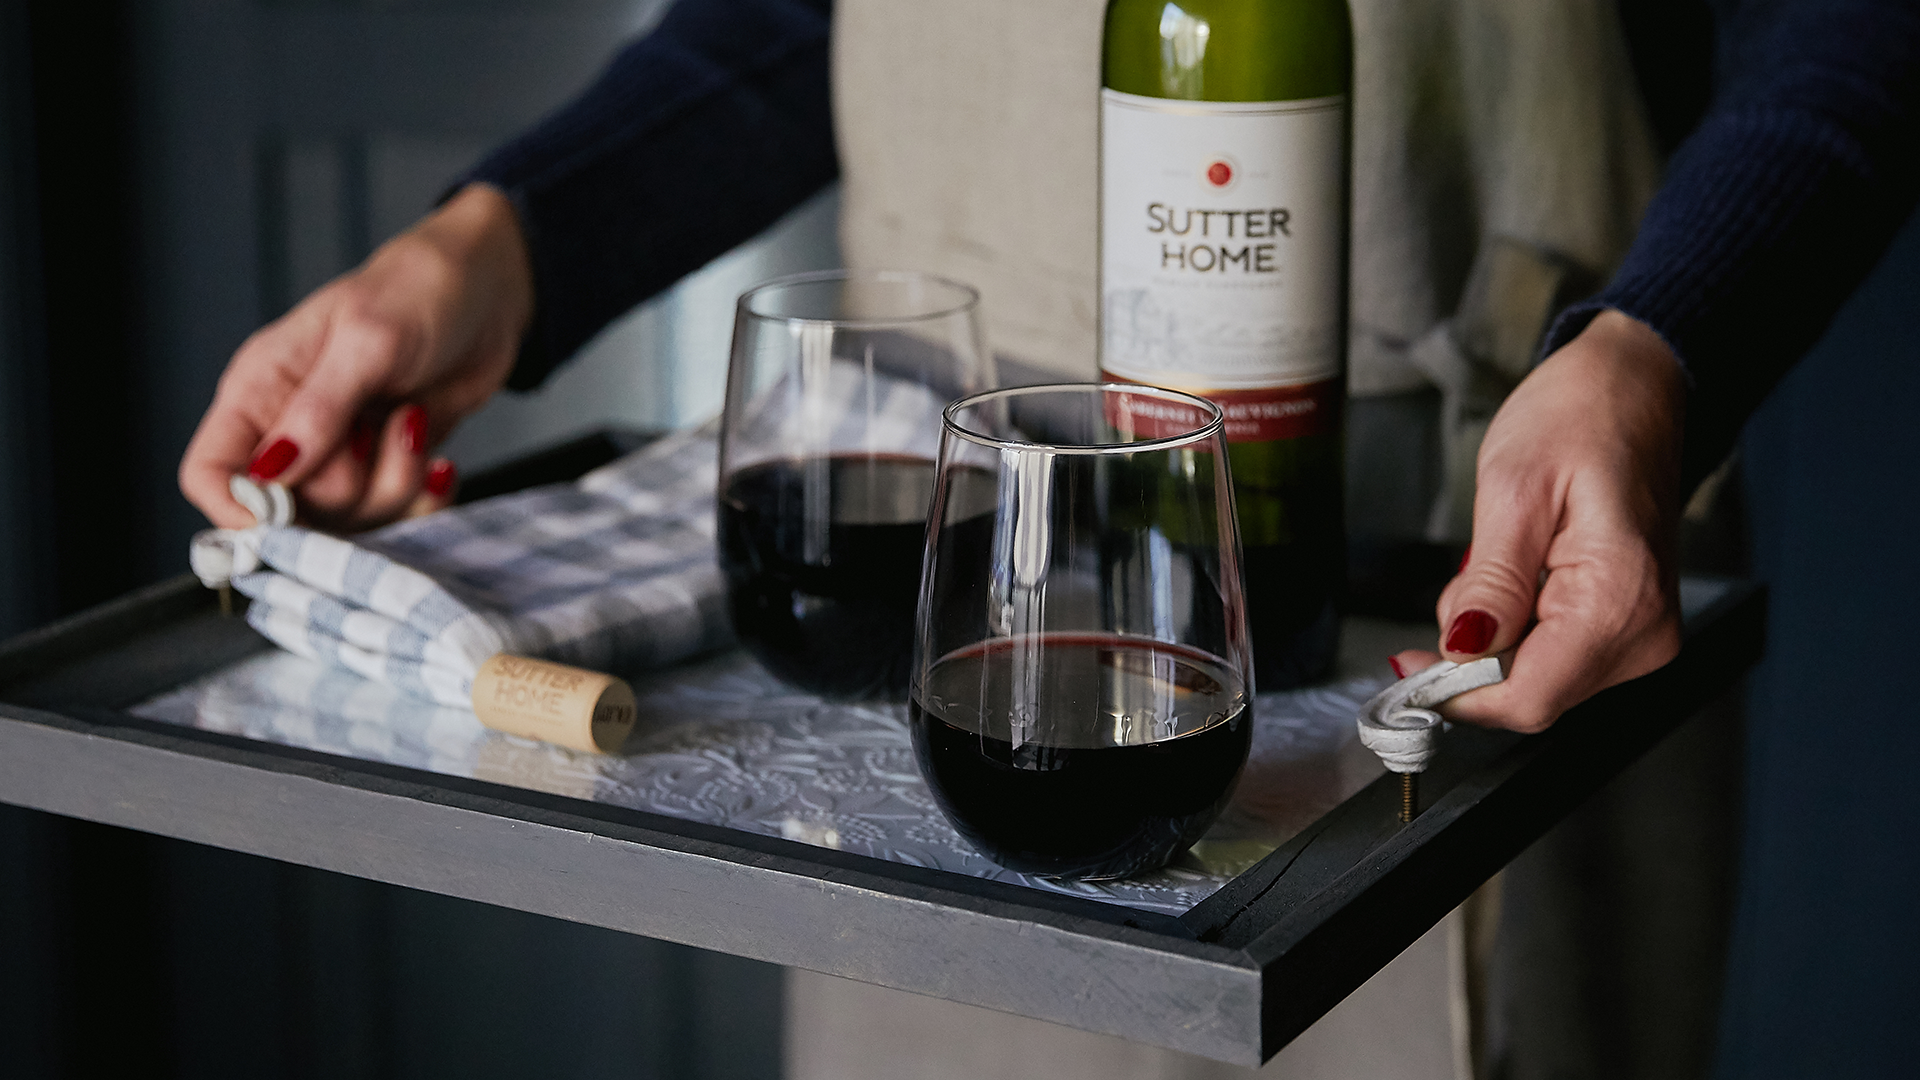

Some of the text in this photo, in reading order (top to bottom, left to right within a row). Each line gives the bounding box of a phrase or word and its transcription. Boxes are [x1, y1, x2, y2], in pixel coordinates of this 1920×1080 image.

[1146, 202, 1291, 239] SUTTER
[1161, 242, 1279, 274] HOME
[493, 656, 586, 692] SUTTER
[494, 679, 564, 715] HOME
